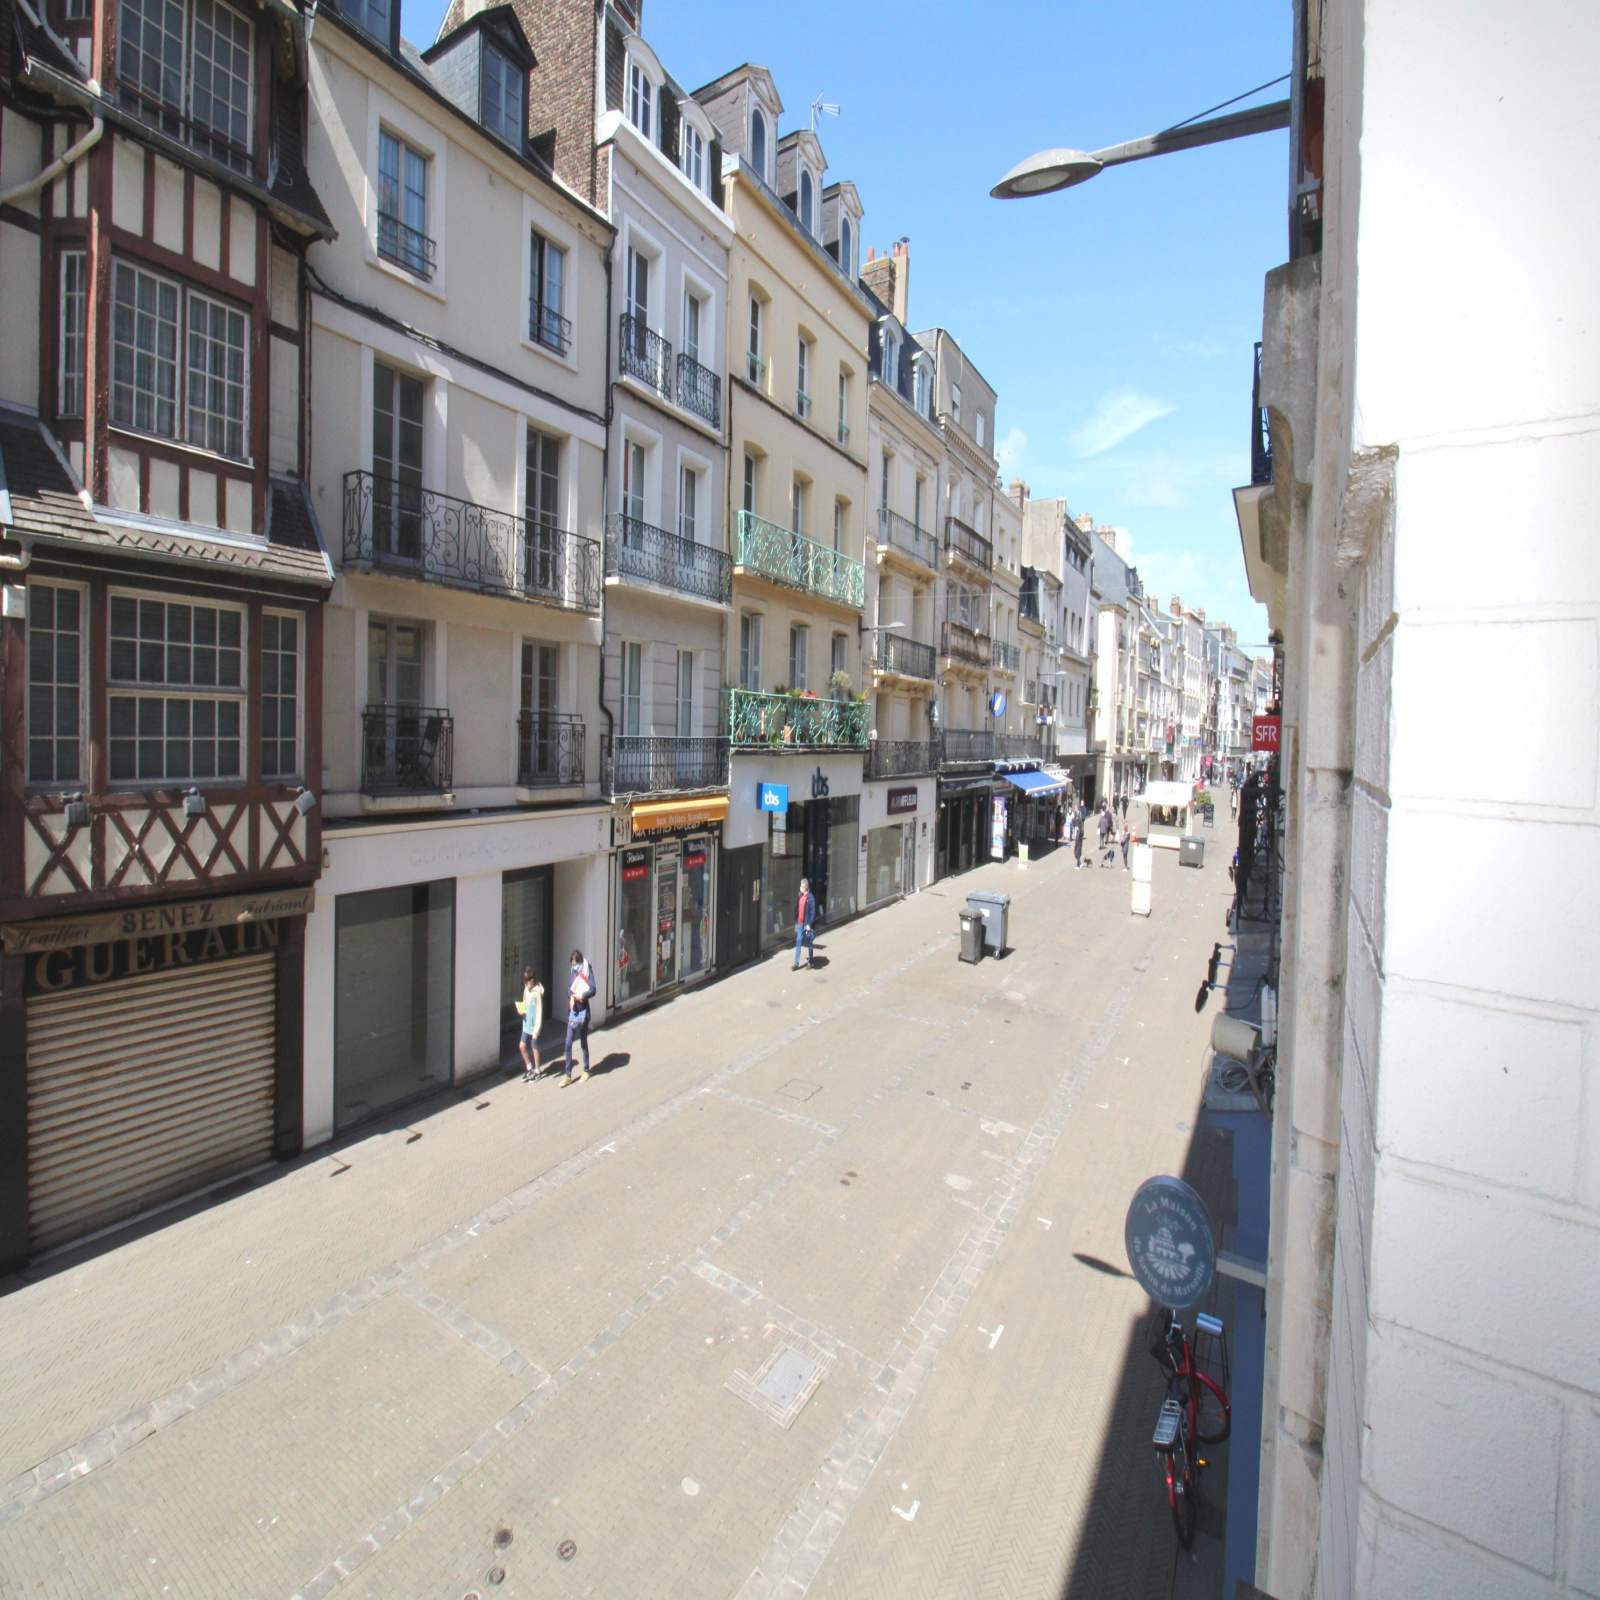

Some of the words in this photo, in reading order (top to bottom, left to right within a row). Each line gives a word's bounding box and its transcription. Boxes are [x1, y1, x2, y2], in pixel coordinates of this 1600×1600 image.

[1255, 725, 1277, 742] SFR
[764, 789, 780, 806] tbs
[811, 766, 829, 799] tbs
[656, 817, 667, 826] Aux
[122, 903, 214, 933] SENEZ
[243, 895, 309, 915] Fabricant
[34, 918, 280, 990] GUERAIN
[1144, 1201, 1158, 1214] La
[1160, 1197, 1197, 1232] Maison
[1133, 1236, 1142, 1253] du
[1137, 1255, 1160, 1288] Savon
[1174, 1260, 1206, 1297] Marseille
[1161, 1284, 1172, 1296] de
